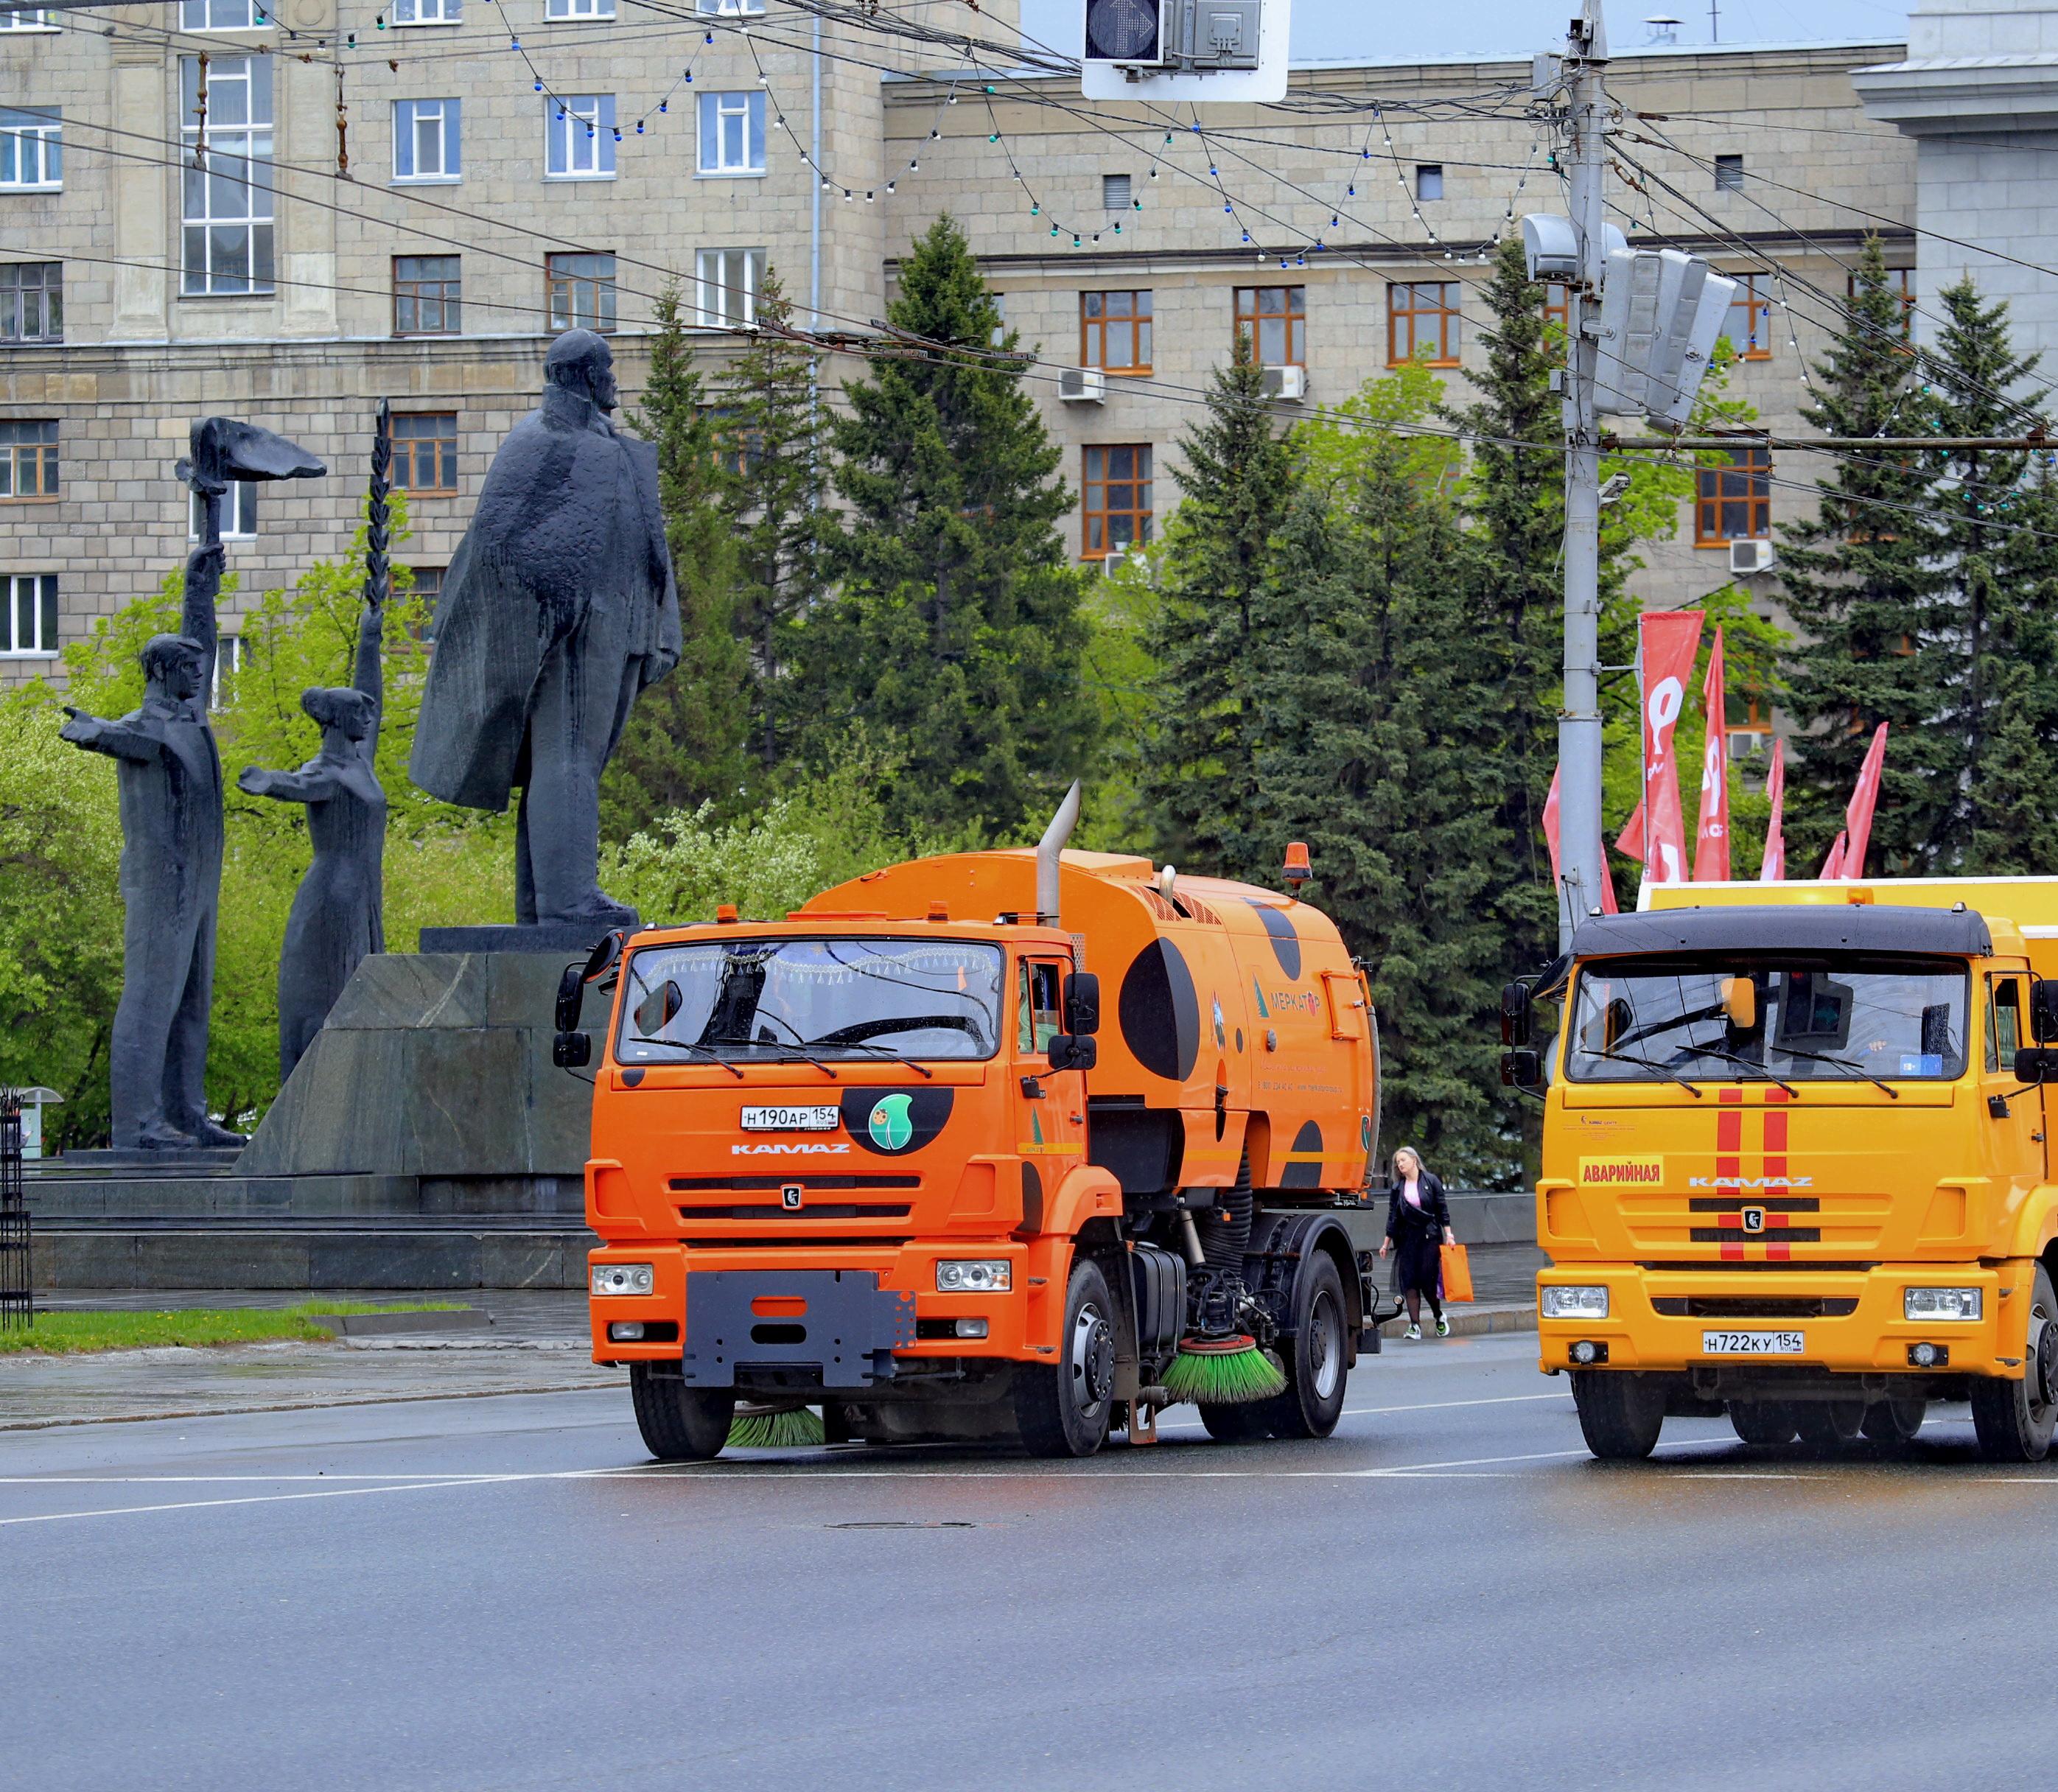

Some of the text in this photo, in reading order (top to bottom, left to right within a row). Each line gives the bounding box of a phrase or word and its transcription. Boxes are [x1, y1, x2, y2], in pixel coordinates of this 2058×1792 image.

[747, 1107, 835, 1125] Н190АР 154
[732, 1144, 850, 1155] KAMAZ
[1583, 1161, 1660, 1183] АВАРИЙНАЯ
[1689, 1177, 1813, 1188] KAMAZ
[1708, 1334, 1801, 1351] Н722КУ 154
